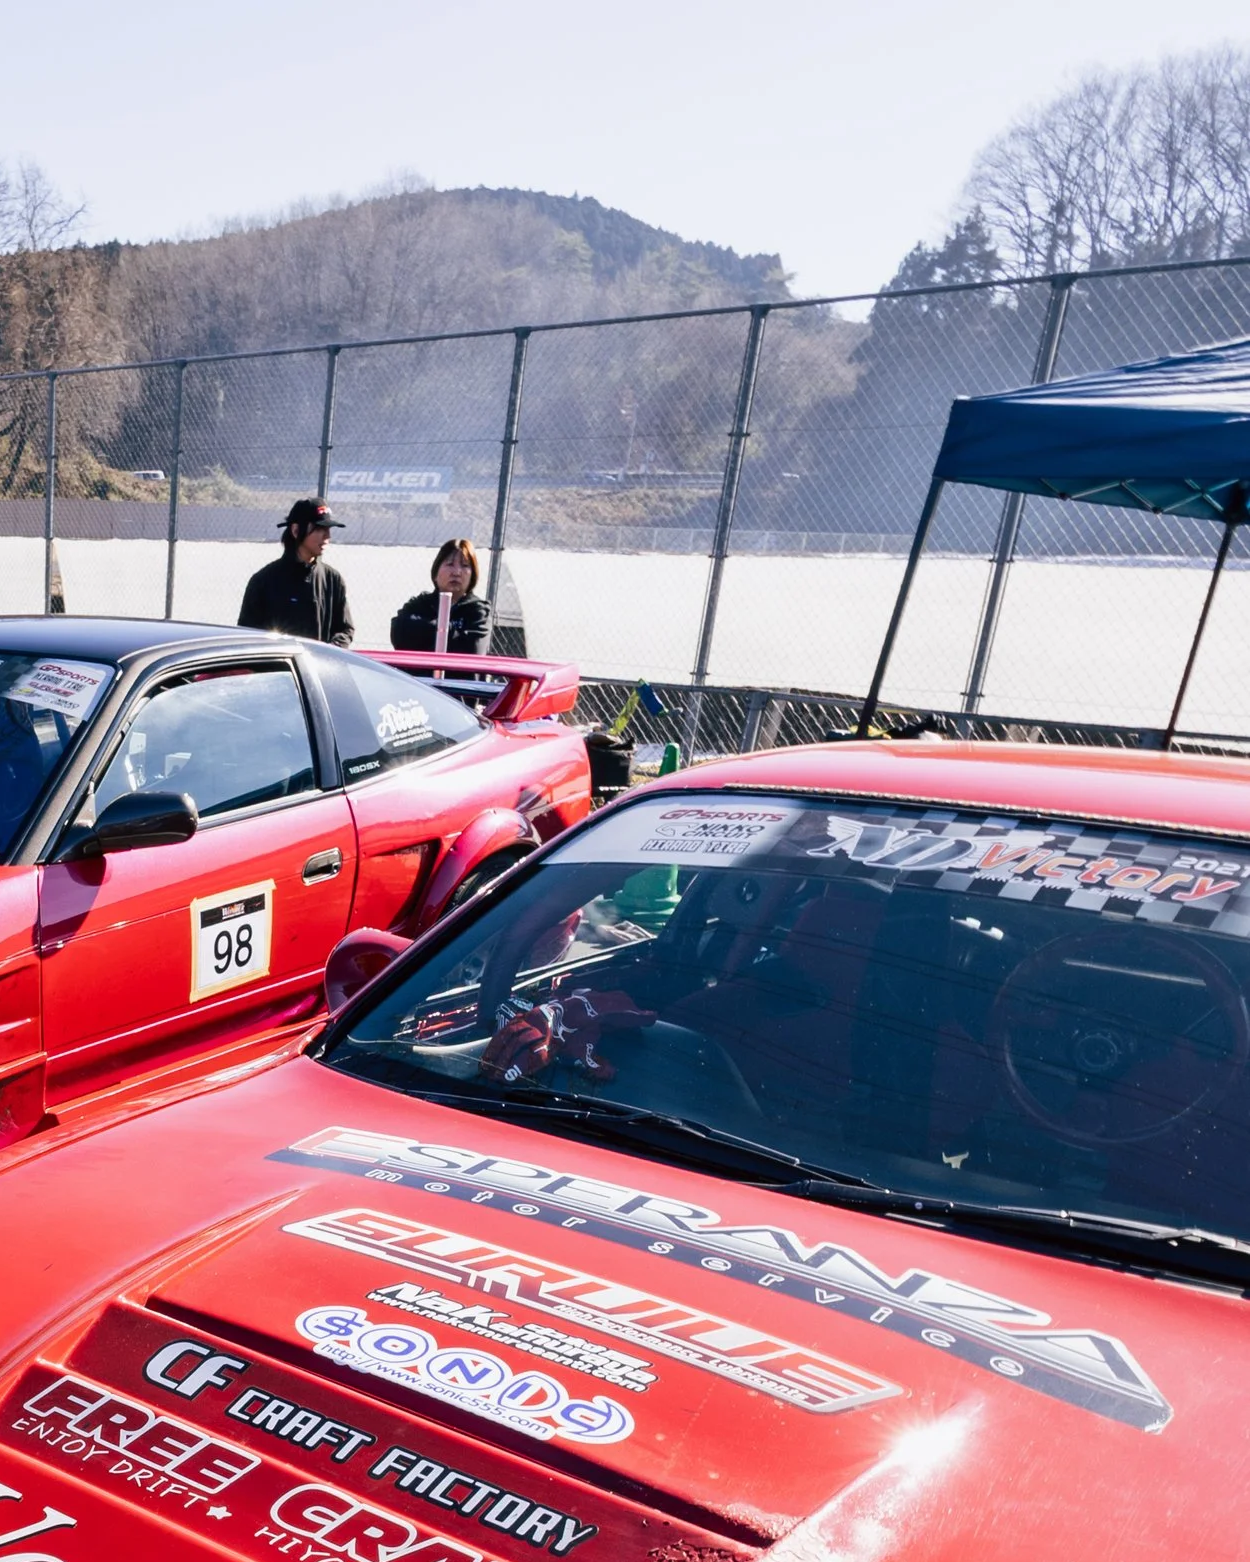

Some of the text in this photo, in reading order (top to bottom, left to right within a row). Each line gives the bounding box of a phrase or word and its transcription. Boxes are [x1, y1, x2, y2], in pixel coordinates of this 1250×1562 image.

[329, 470, 442, 488] FALKEN
[349, 760, 381, 775] 180SX
[681, 830, 759, 838] CIRCUIT
[694, 823, 766, 833] NIKKO
[703, 840, 752, 855] TIRE
[976, 842, 1241, 901] Victory
[213, 923, 253, 974] 98
[286, 1126, 1162, 1404] ESPERANZA
[364, 1168, 1026, 1378] motor service
[300, 1309, 627, 1438] SONIC
[320, 1342, 548, 1436] http://www.sonic555.com
[708, 1358, 811, 1402] Lubricants
[11, 1417, 209, 1508] ENJOY DRIFT
[23, 1375, 262, 1494] FREE
[144, 1340, 600, 1557] CF CRAFT FACTORY
